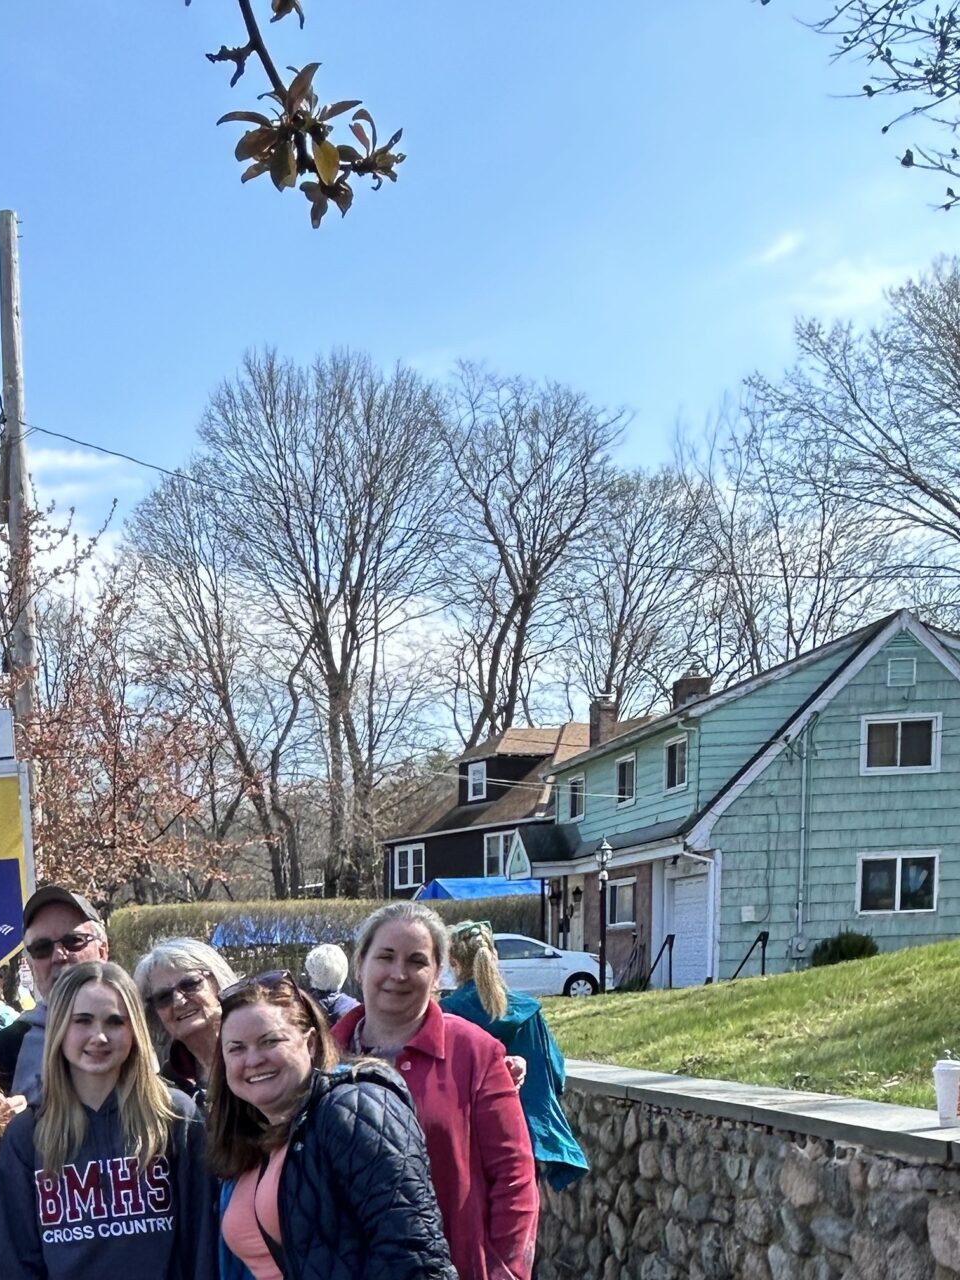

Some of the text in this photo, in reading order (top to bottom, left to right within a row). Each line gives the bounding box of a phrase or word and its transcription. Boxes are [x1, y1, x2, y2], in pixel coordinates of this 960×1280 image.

[34, 1154, 172, 1226] BMHS
[42, 1215, 174, 1244] CROSS COUNTRY
